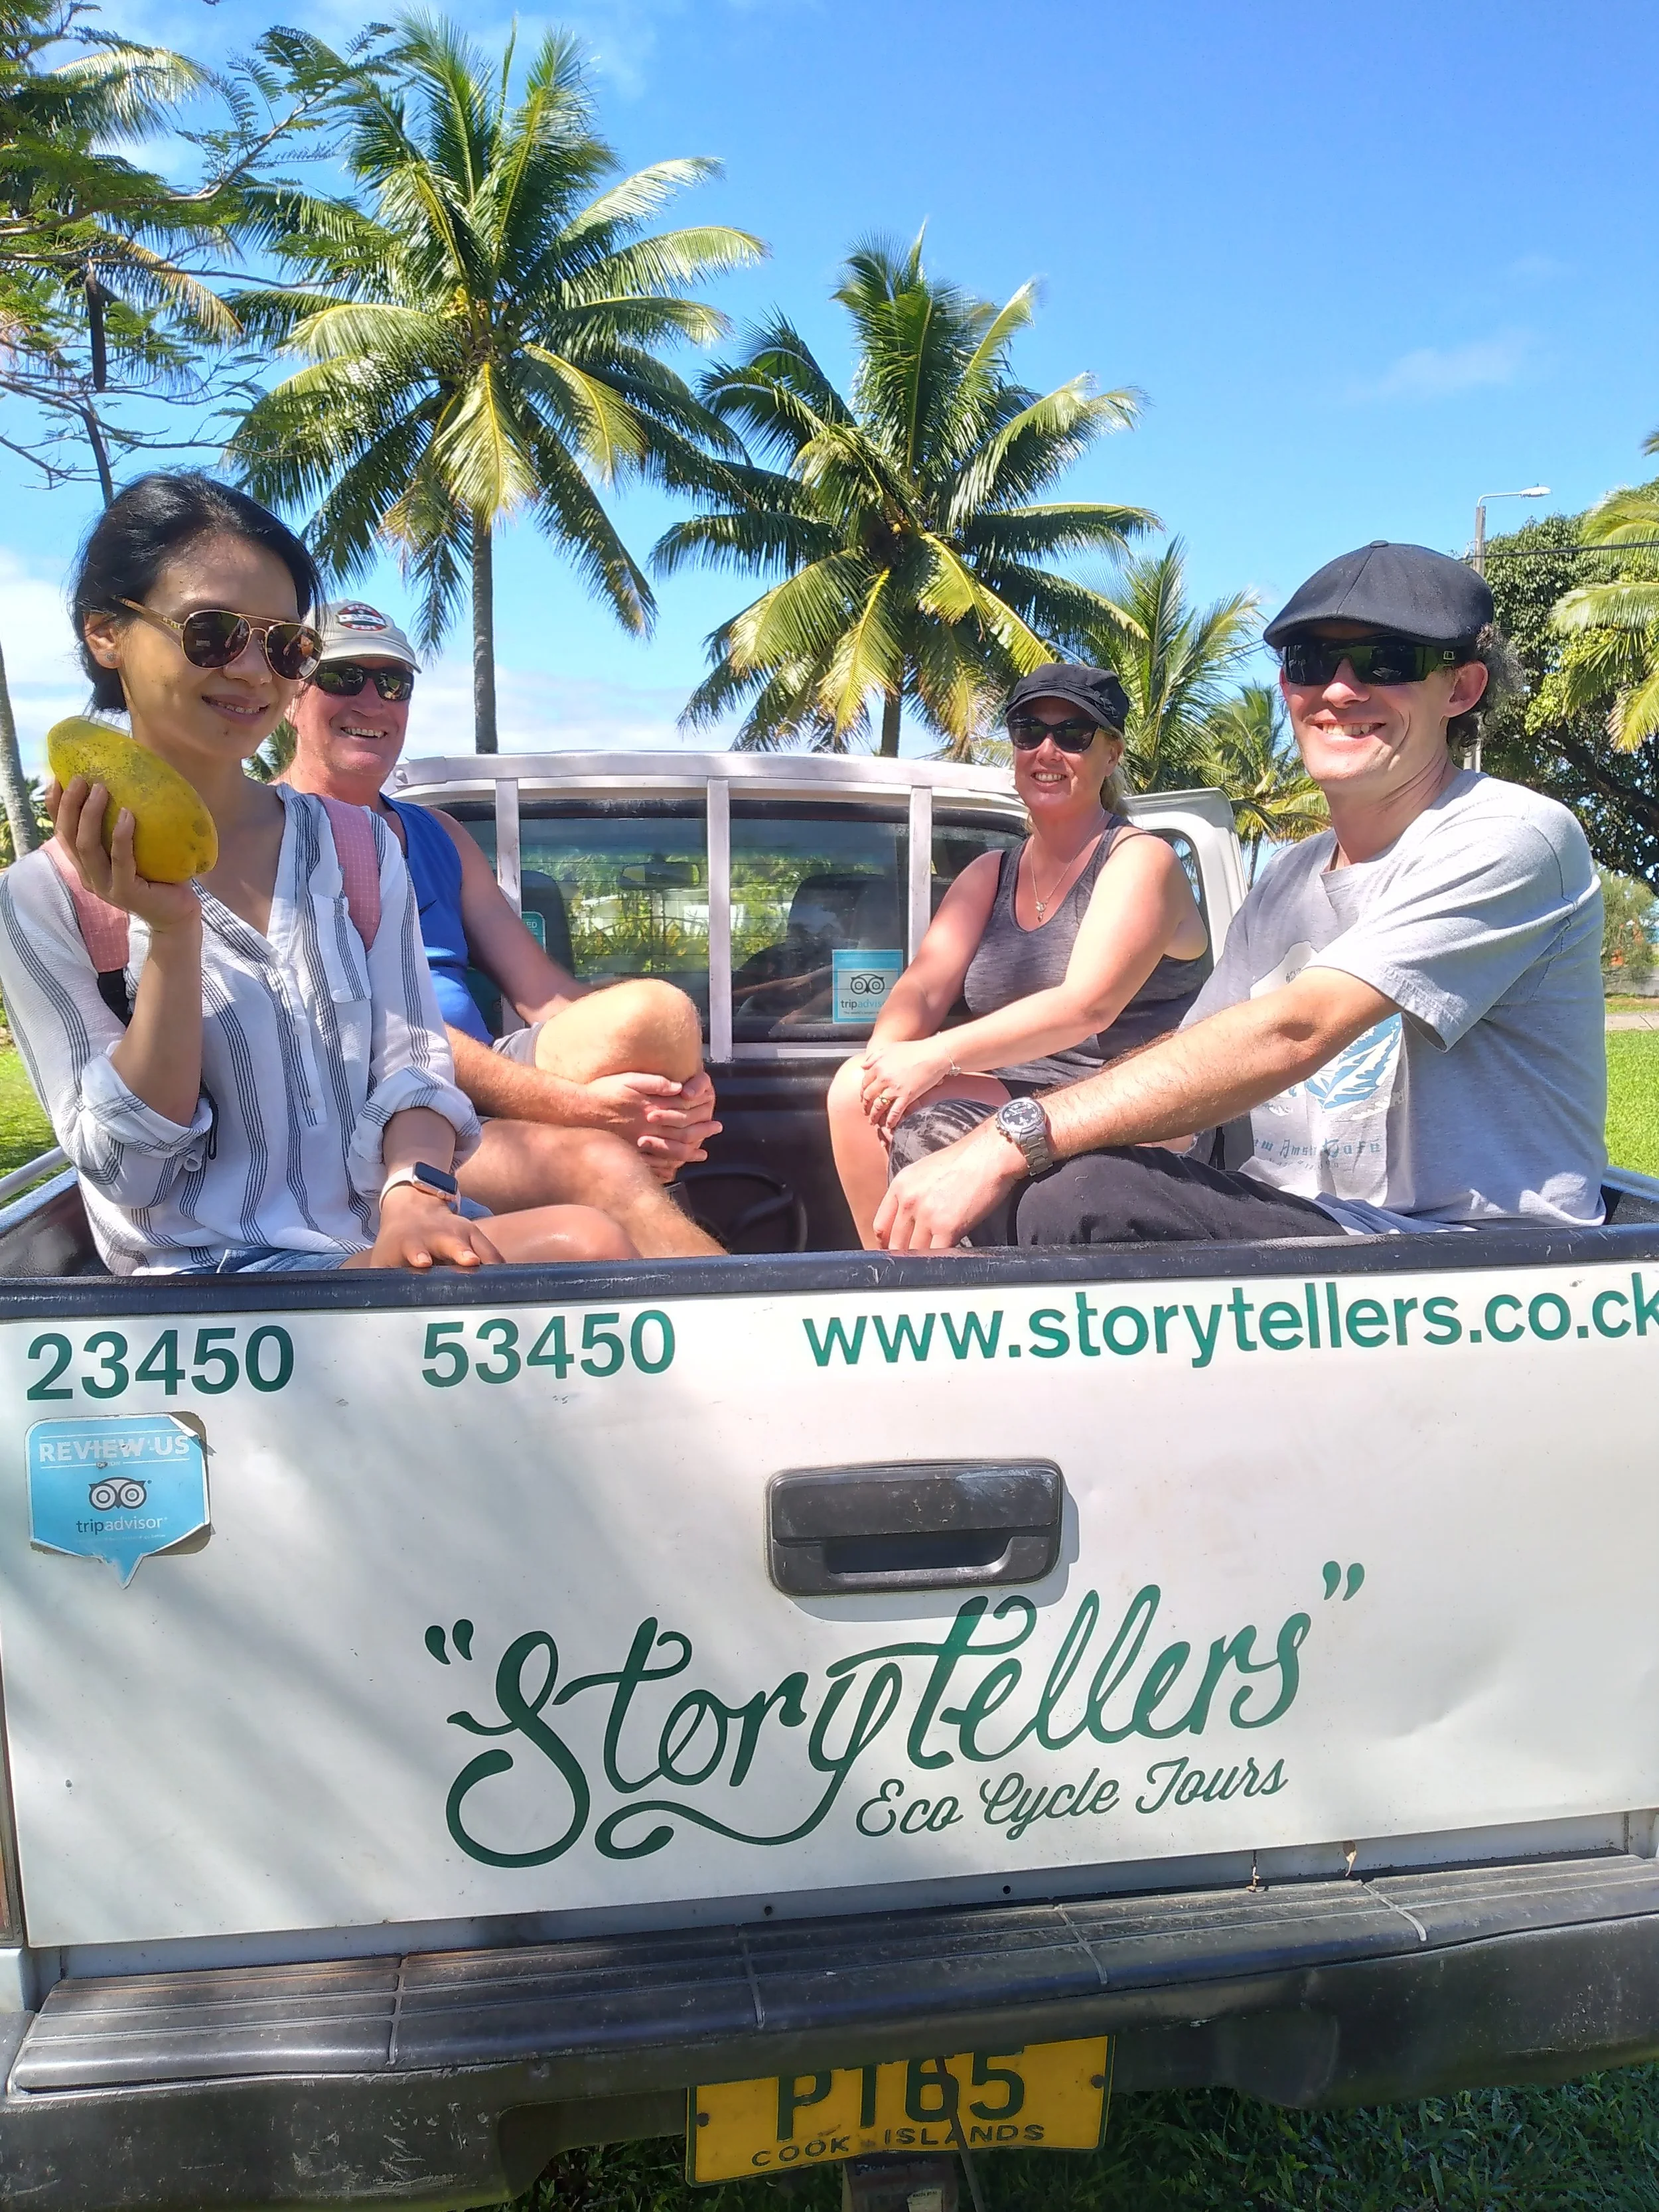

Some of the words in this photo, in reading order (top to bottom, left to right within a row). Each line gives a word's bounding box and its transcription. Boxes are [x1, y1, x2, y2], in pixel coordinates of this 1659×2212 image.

[840, 999, 881, 1009] tripadvis
[421, 1310, 676, 1388] 53450
[802, 1272, 1659, 1368] www.storytellers.co.ck
[27, 1325, 295, 1401] 23450
[40, 1438, 145, 1462] REVIEW
[155, 1435, 190, 1455] US
[76, 1516, 163, 1535] tripadvisor
[856, 1779, 964, 1837] Eco
[980, 1768, 1120, 1840] Cycle
[1135, 1757, 1289, 1814] Tours
[751, 2134, 850, 2167] COOK
[884, 2124, 1045, 2146] ISLANDS
